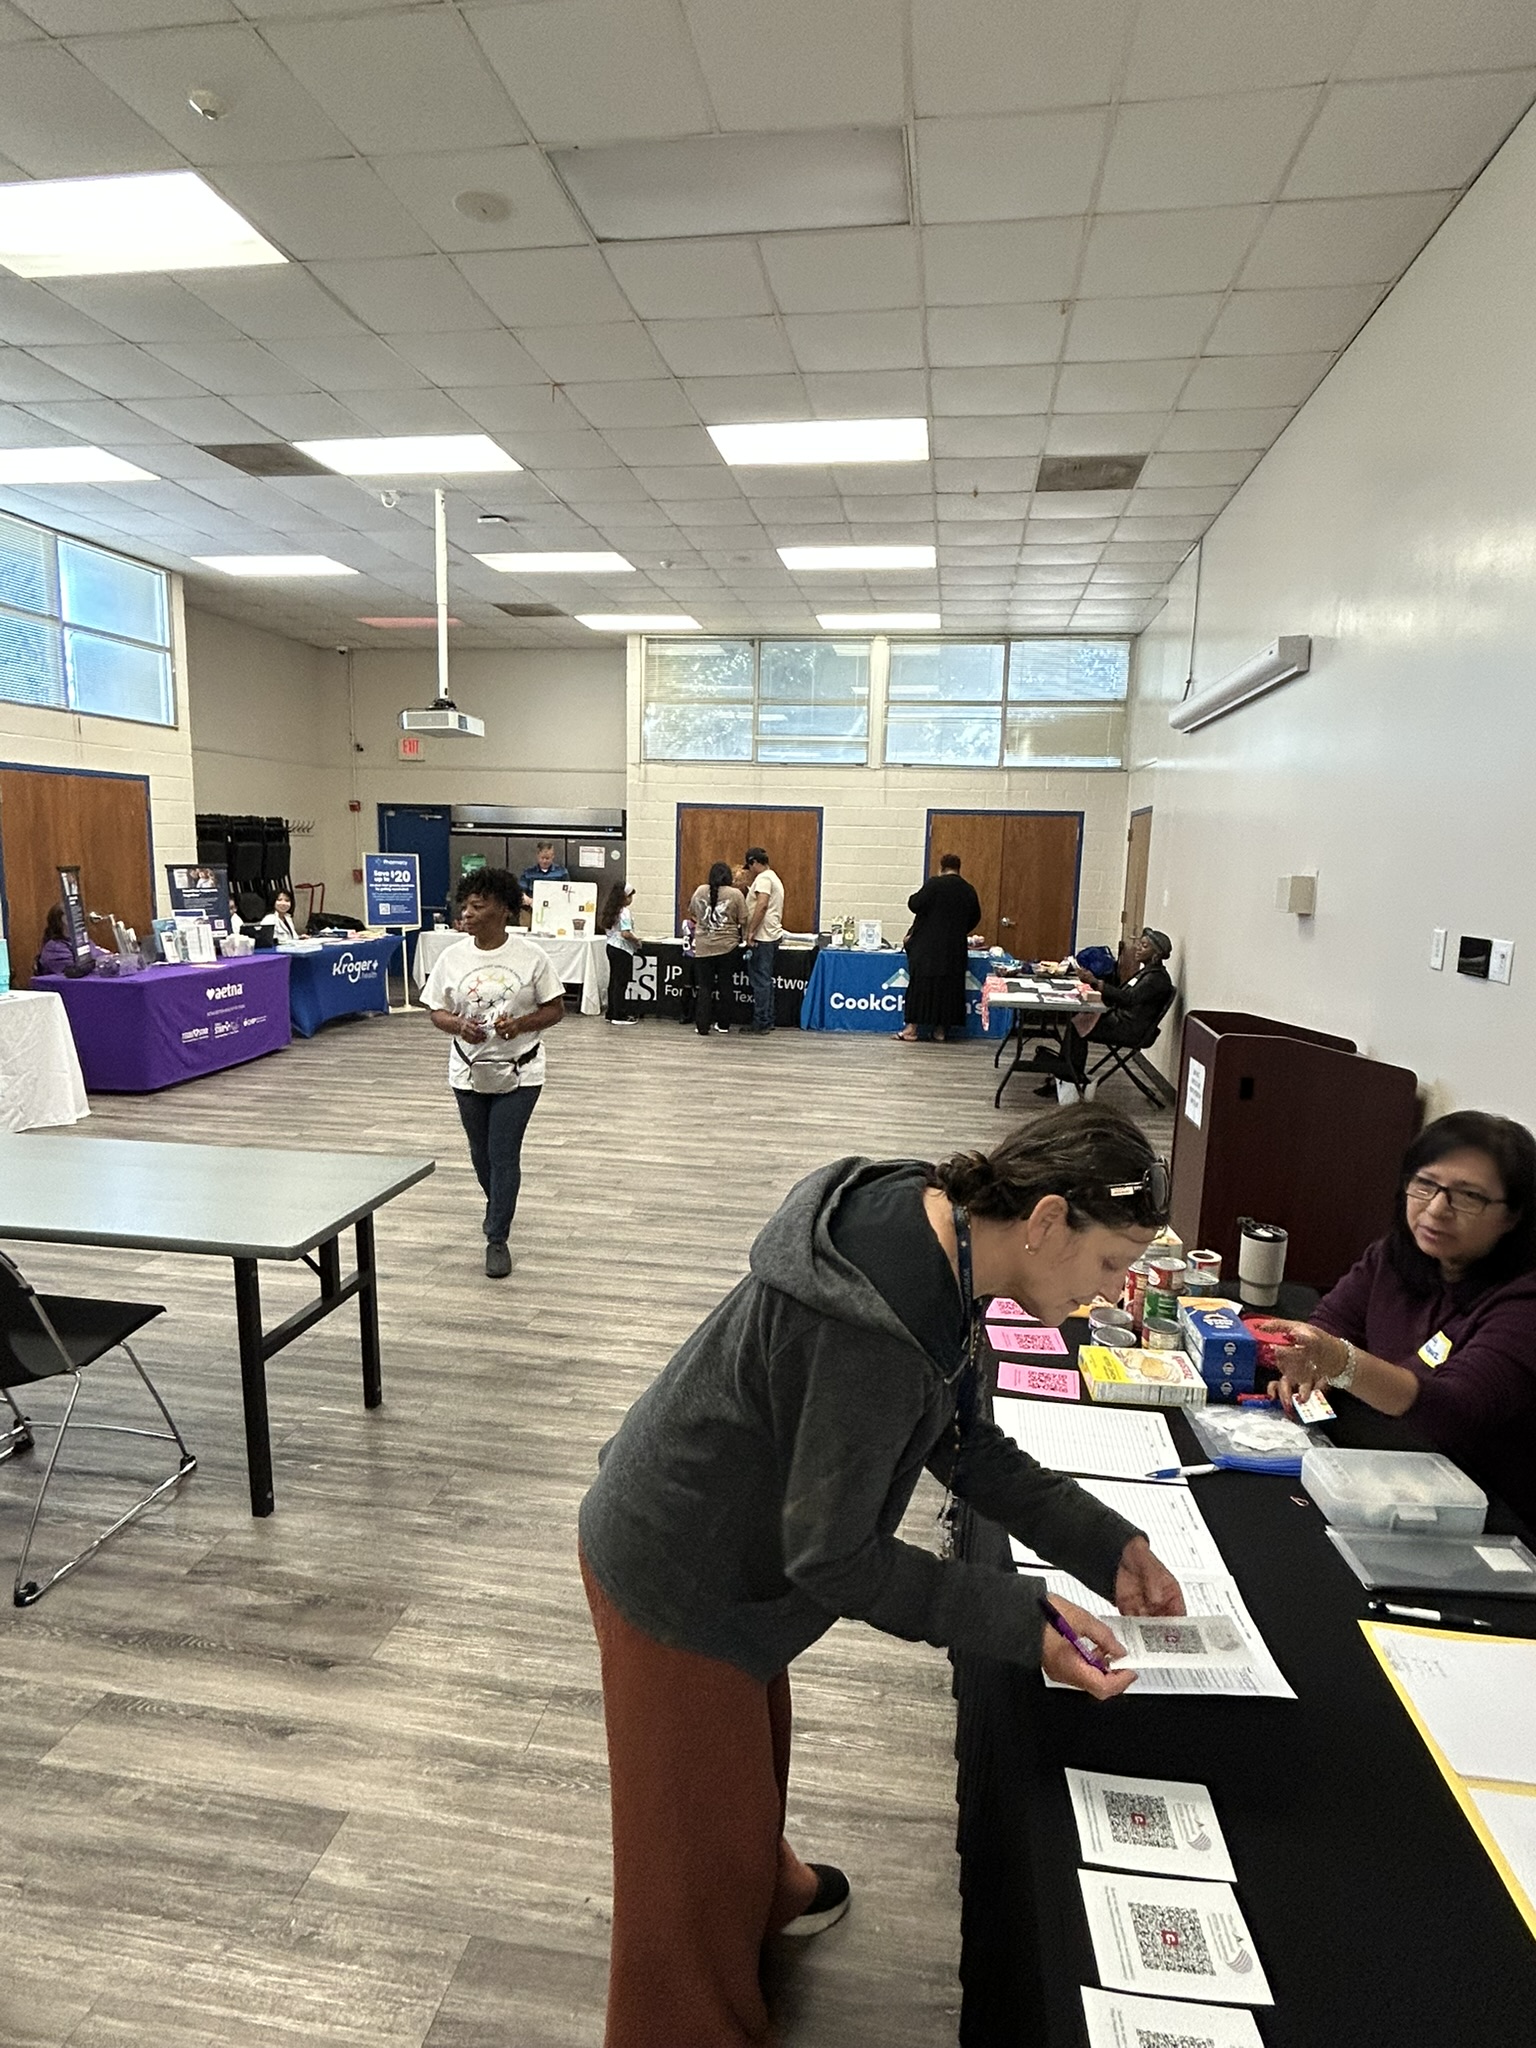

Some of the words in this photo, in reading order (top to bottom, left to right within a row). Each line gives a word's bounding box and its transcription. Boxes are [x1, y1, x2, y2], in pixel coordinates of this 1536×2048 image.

[391, 870, 411, 883] $20
[332, 952, 372, 983] Kroger
[215, 983, 243, 1000] aetna
[664, 984, 684, 997] For
[733, 990, 756, 1003] Tex
